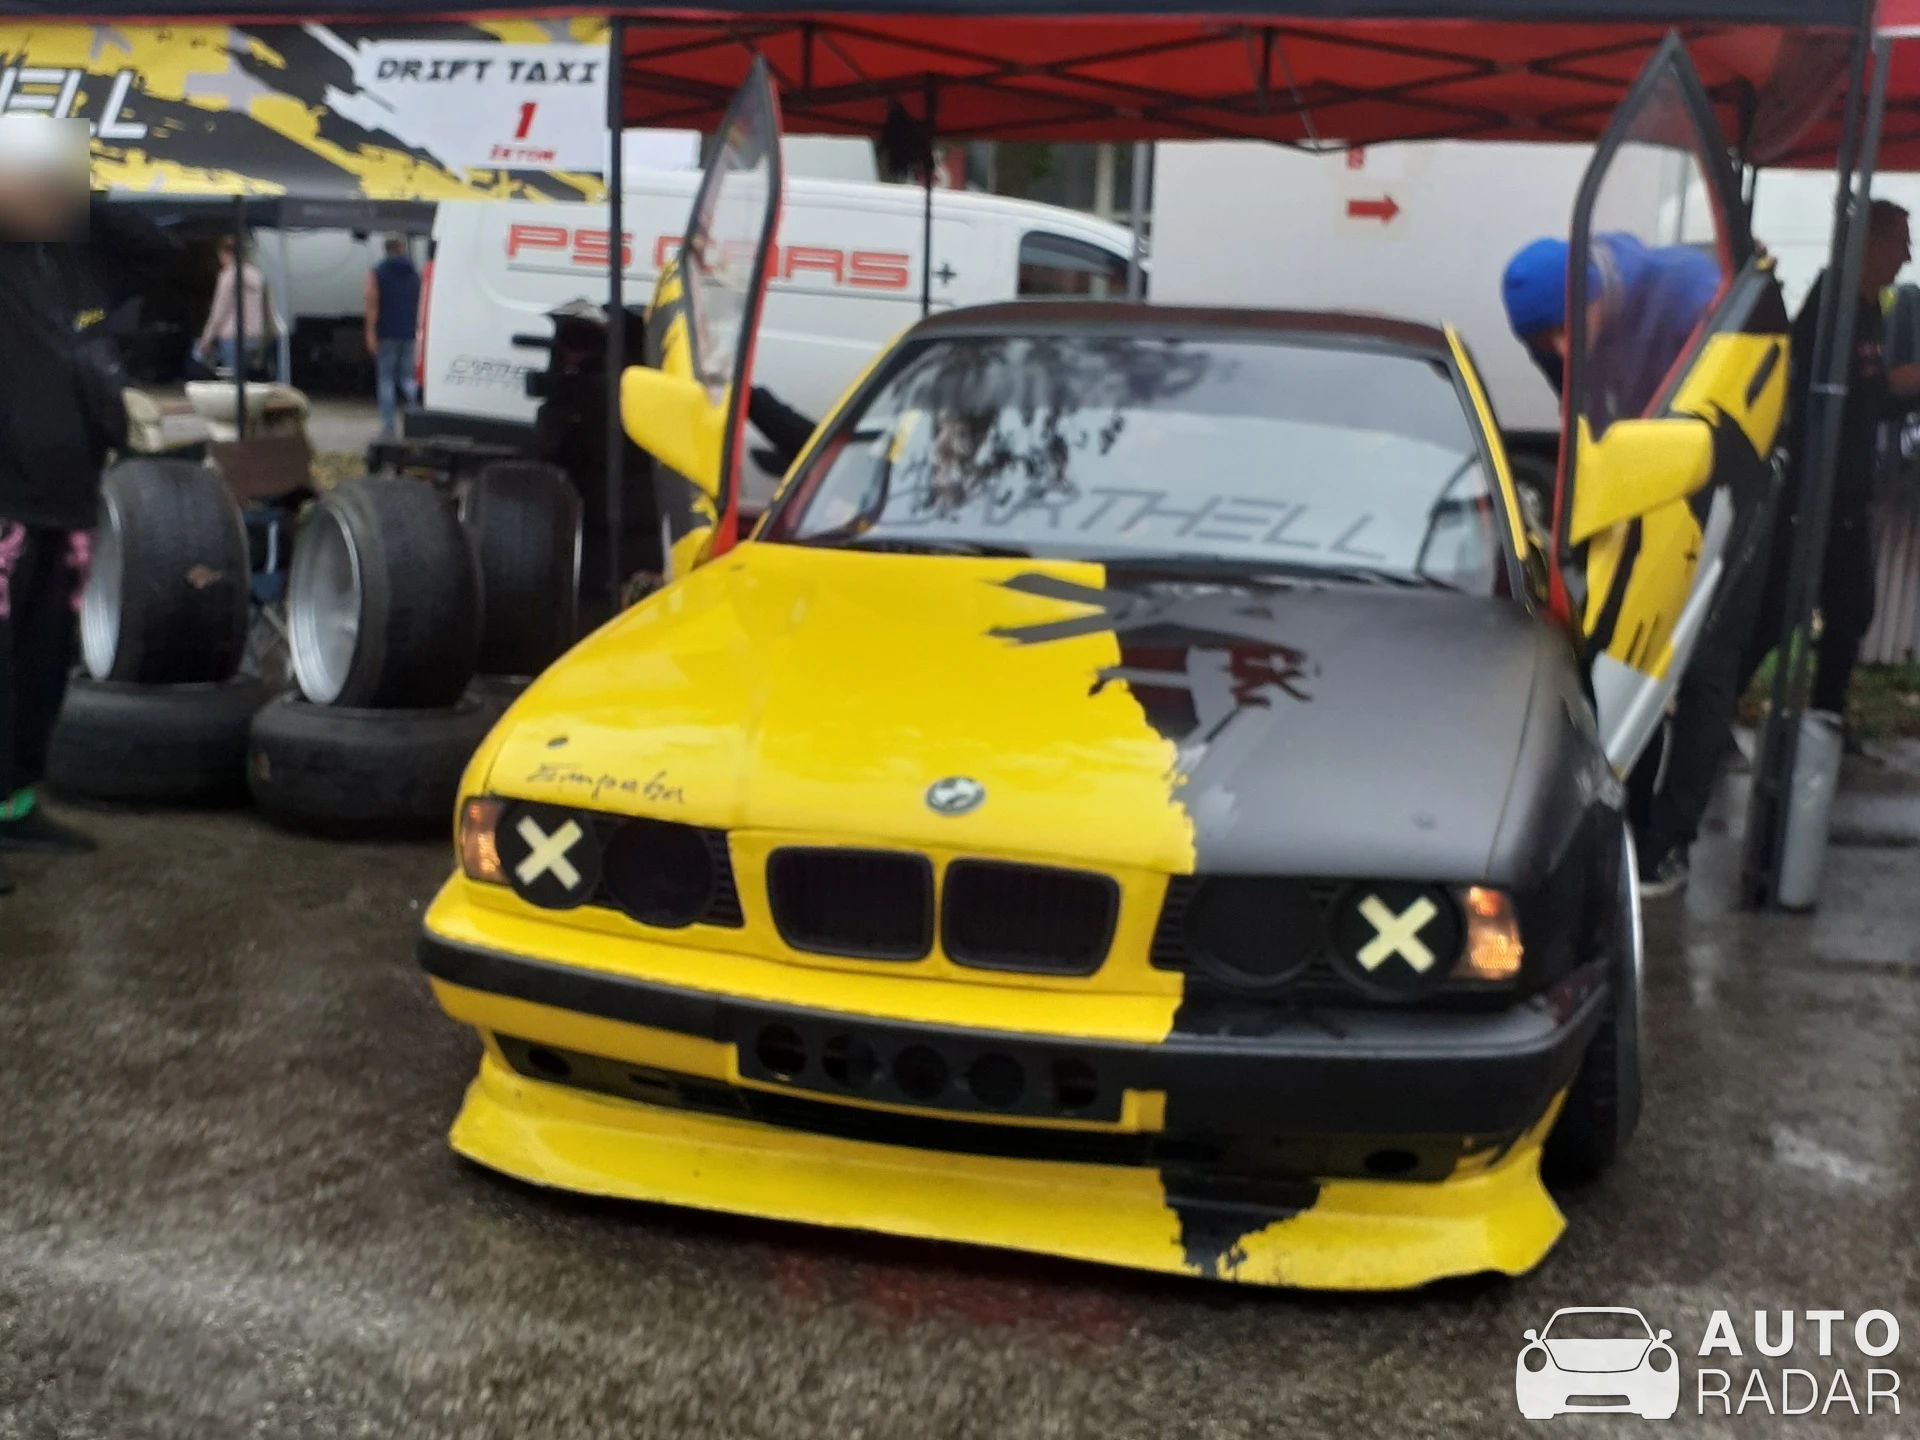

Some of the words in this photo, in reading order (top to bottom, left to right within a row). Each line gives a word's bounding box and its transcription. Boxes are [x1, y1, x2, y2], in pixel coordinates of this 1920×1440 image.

[377, 59, 492, 82] DRIFT
[509, 60, 599, 83] TAXI
[514, 101, 538, 139] 1
[506, 224, 634, 268] PS
